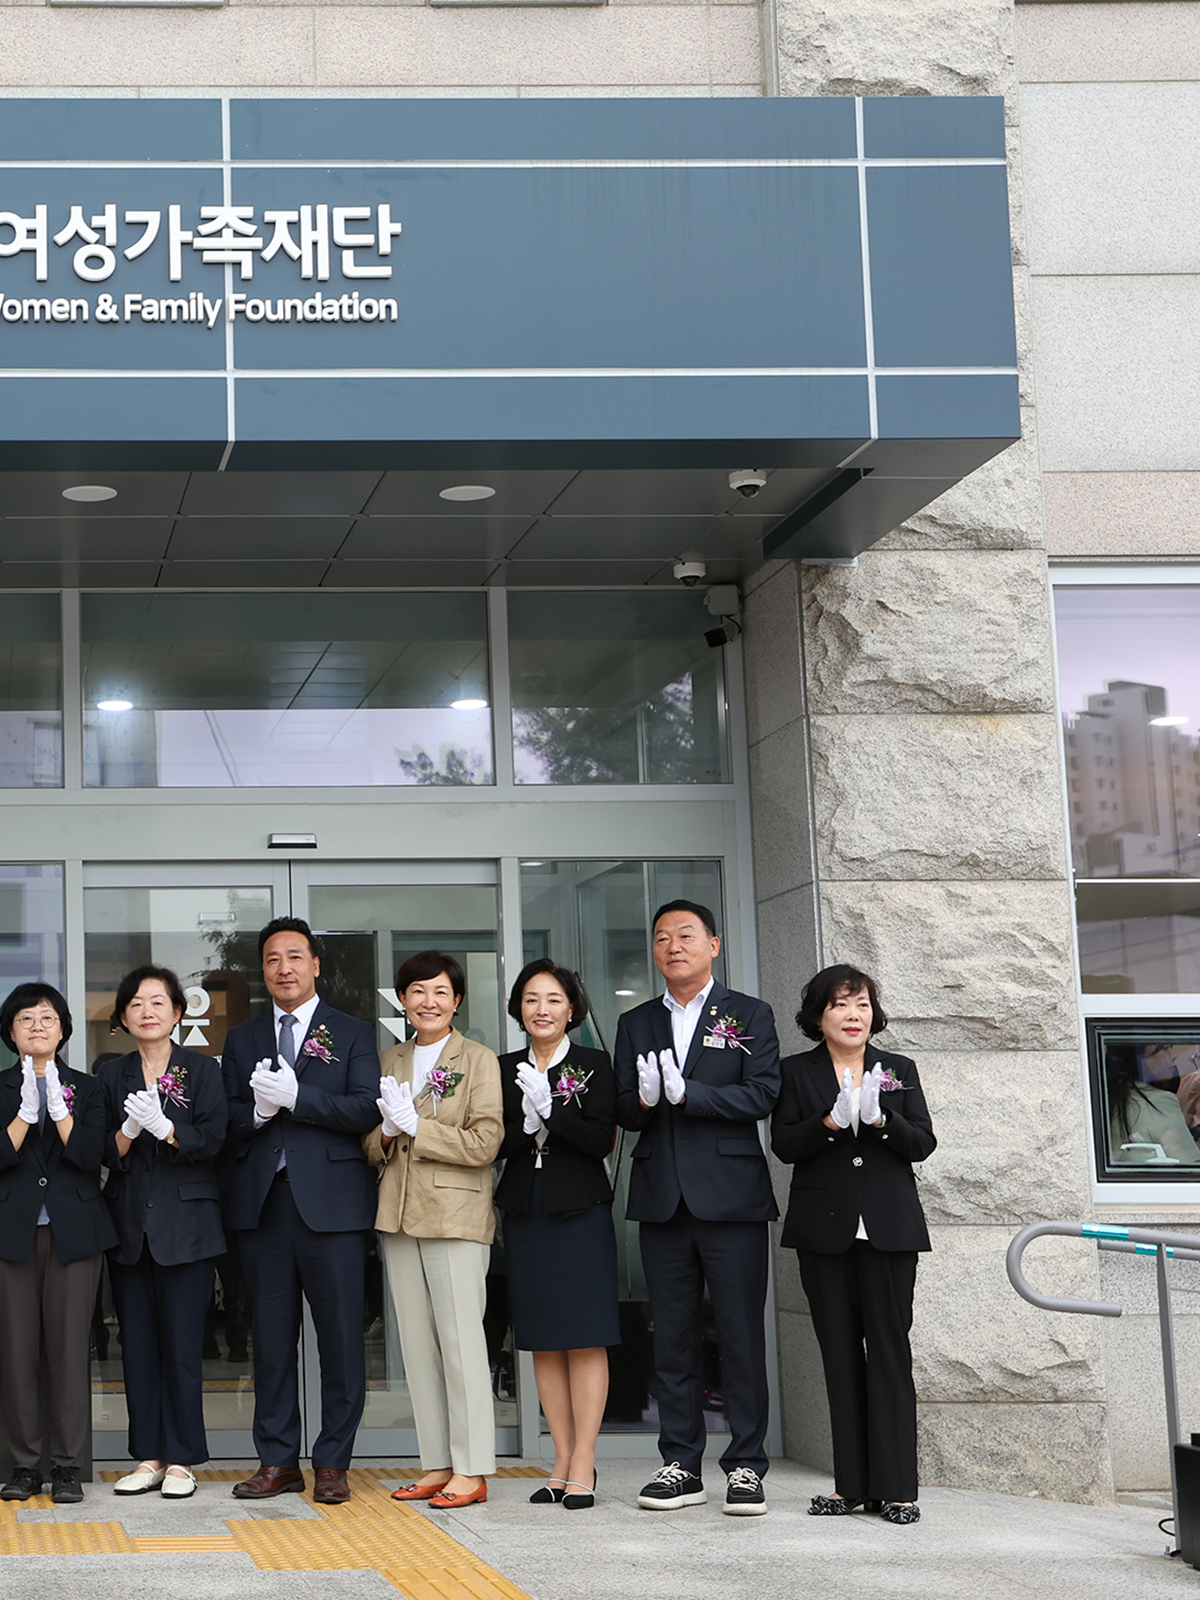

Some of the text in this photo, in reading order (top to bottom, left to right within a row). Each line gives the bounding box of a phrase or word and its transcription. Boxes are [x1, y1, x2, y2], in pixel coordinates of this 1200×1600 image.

[95, 293, 121, 322] &
[124, 292, 225, 328] Family
[226, 291, 399, 322] Foundation
